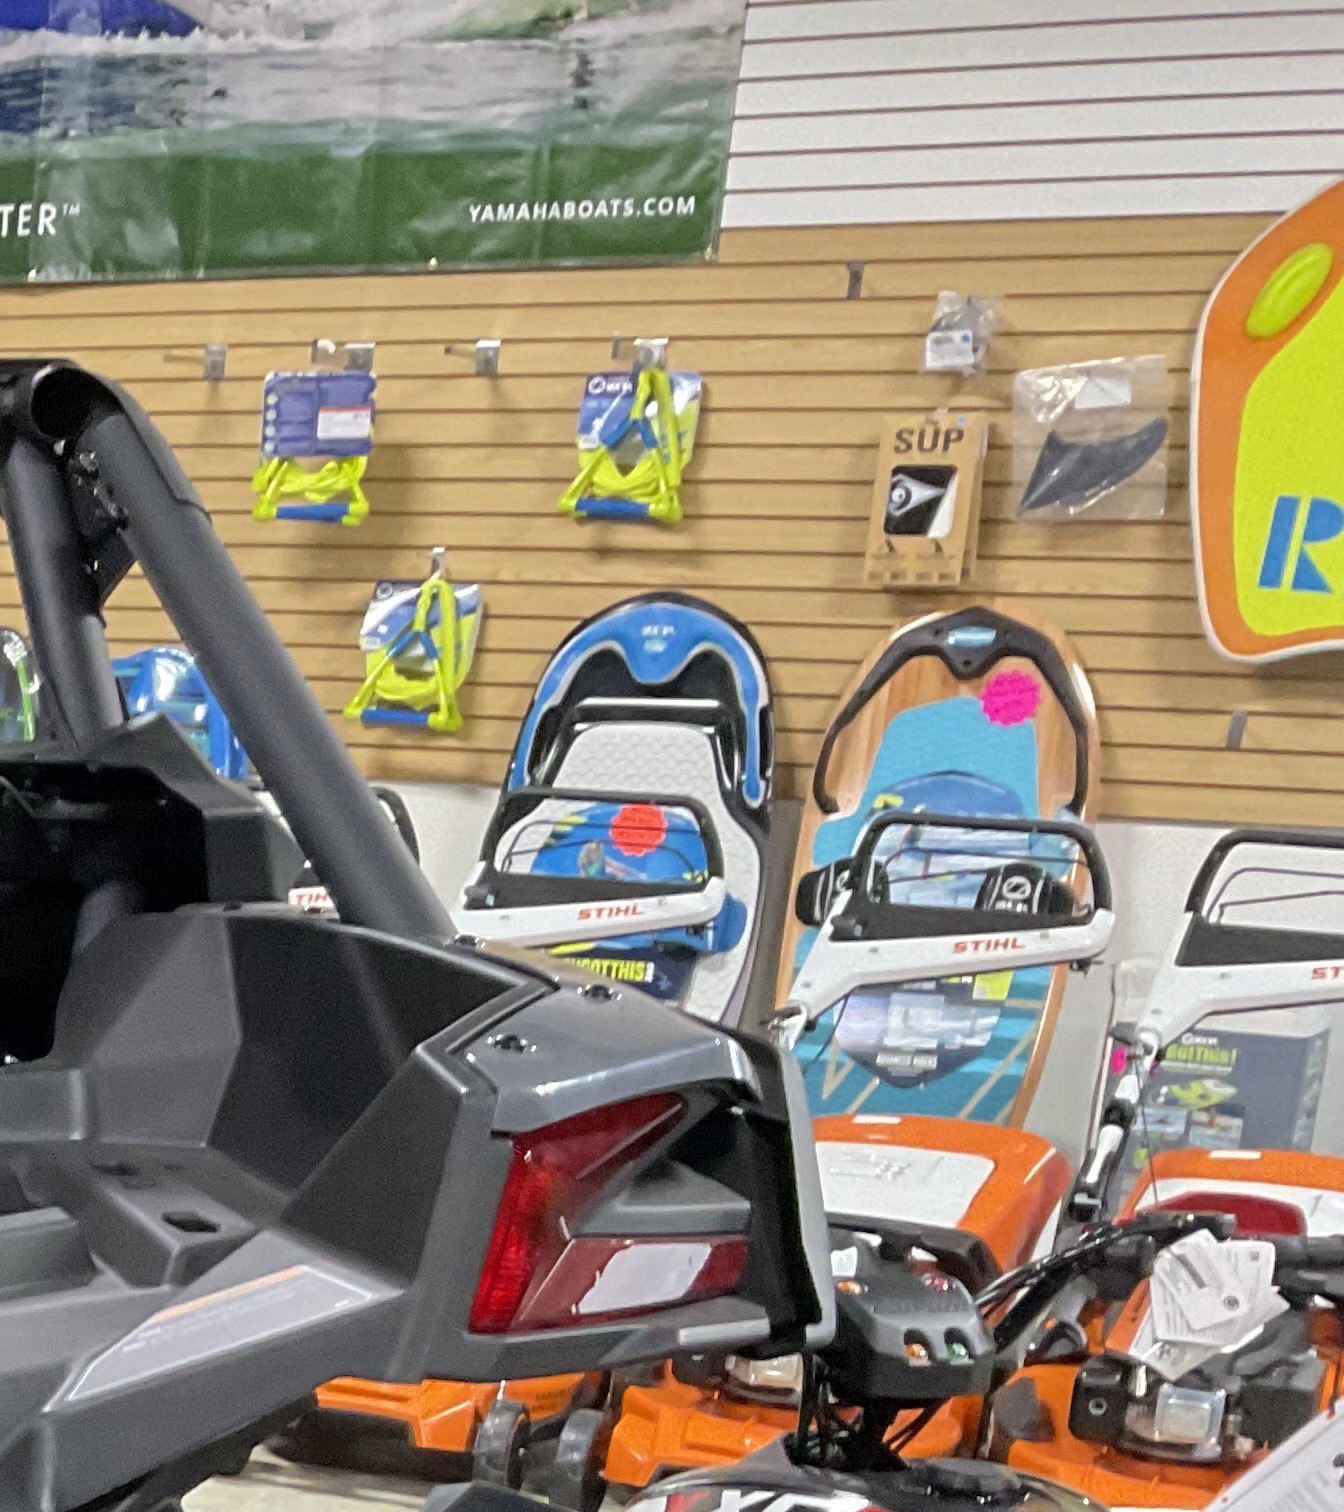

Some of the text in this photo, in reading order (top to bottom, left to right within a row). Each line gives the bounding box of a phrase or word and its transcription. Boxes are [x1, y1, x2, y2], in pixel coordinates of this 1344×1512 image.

[469, 195, 697, 223] YAMAHABOATS.COM
[893, 428, 965, 454] SUP
[577, 903, 644, 921] STIHL
[952, 937, 1025, 954] STIHL
